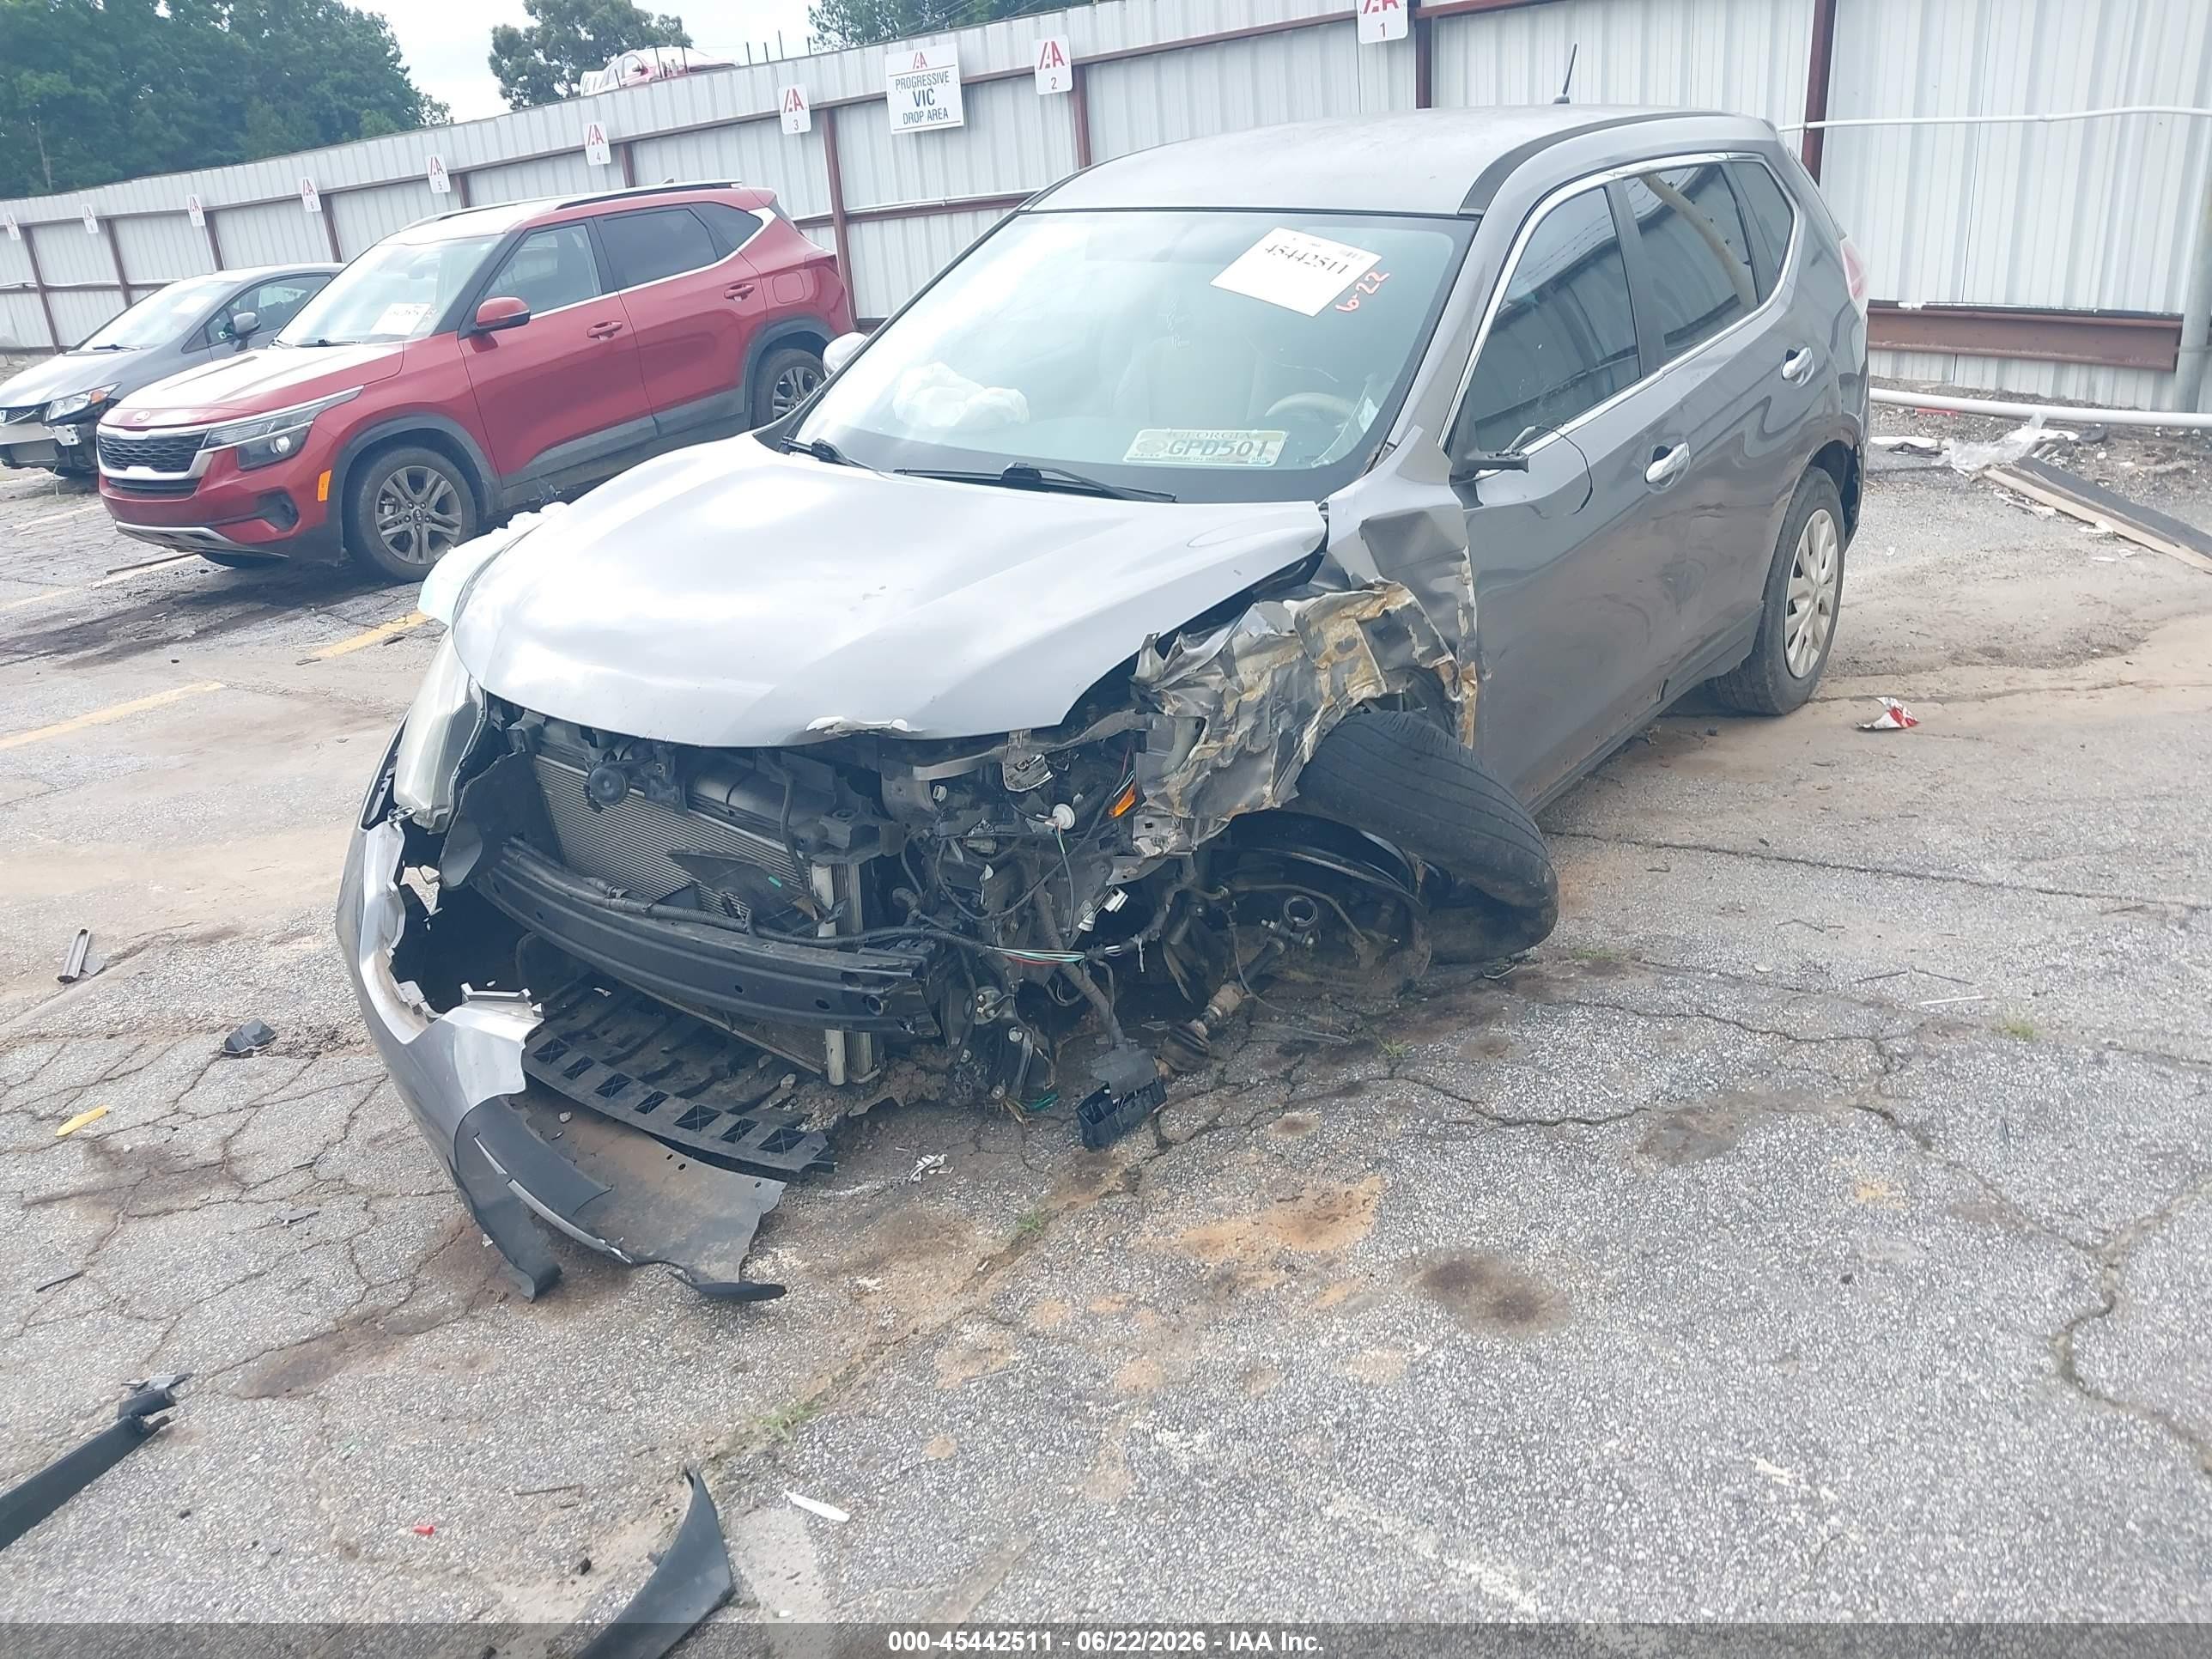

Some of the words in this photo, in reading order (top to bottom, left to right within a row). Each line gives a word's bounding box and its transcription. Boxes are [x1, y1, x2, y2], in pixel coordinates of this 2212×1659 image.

[1379, 22, 1386, 38] 1
[895, 70, 950, 91] PROGRESSIVE
[1050, 76, 1058, 90] 2
[912, 88, 935, 107] VIC
[902, 110, 924, 125] DROP
[927, 106, 949, 122] AREA
[793, 118, 799, 131] 3
[596, 151, 601, 163] 4
